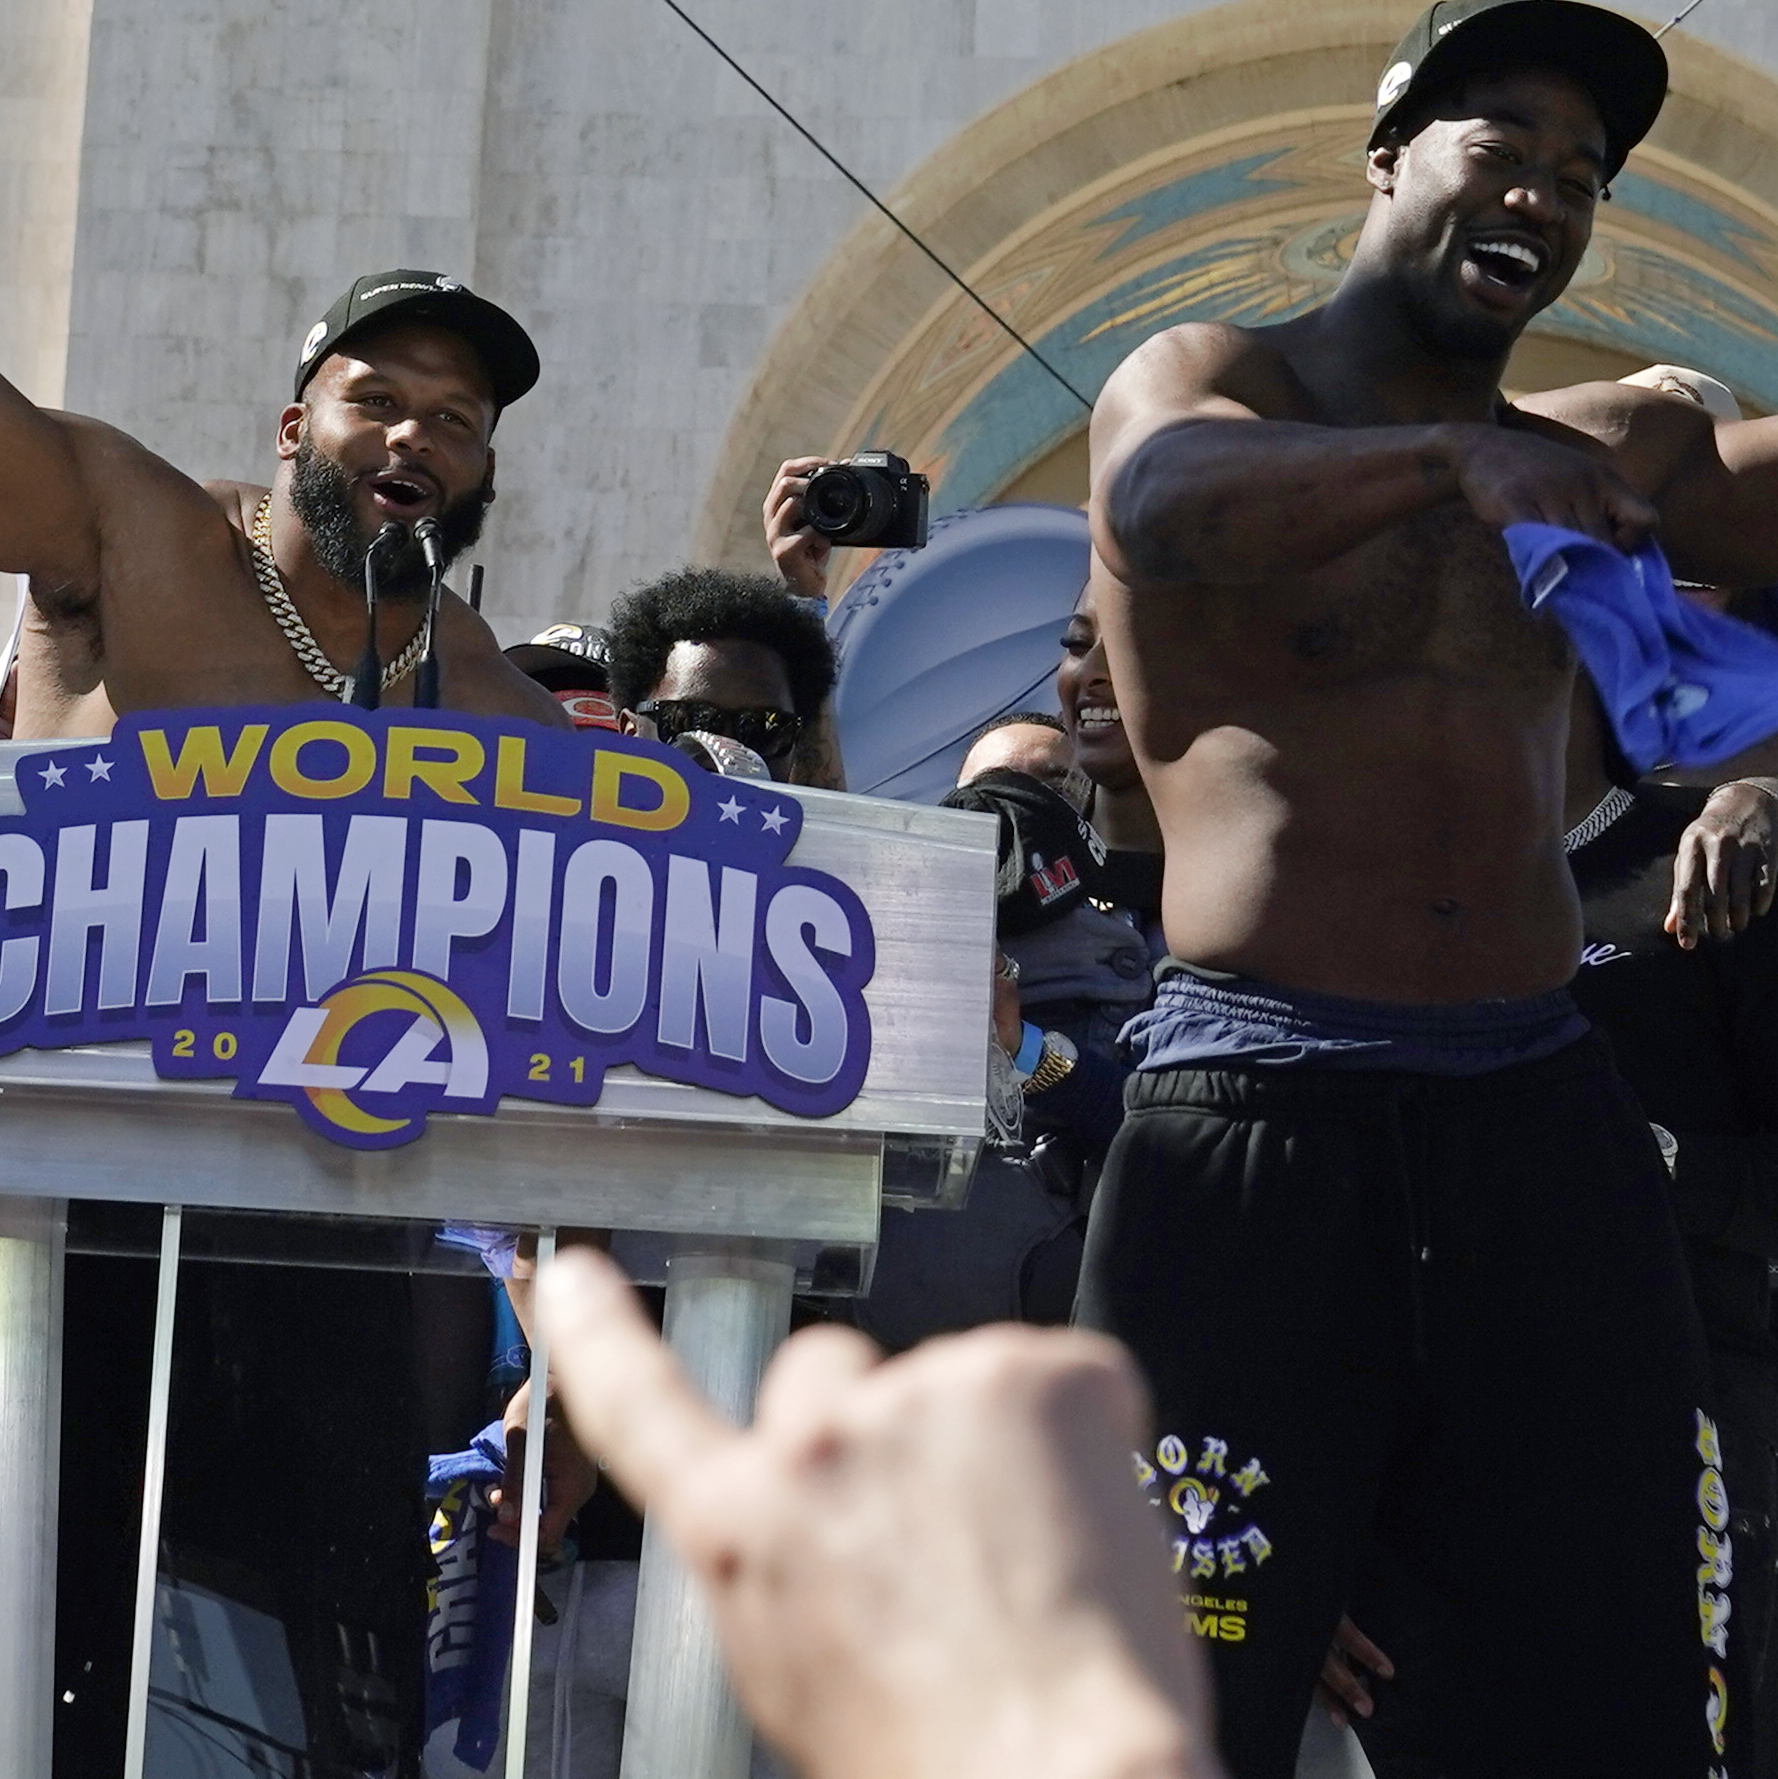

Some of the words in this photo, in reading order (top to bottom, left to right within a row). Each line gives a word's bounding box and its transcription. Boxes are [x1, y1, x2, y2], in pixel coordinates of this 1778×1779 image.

[139, 721, 690, 831] WORLD
[1171, 1524, 1272, 1579] ISED
[1179, 1593, 1248, 1611] NGELES
[1185, 1612, 1246, 1642] MS
